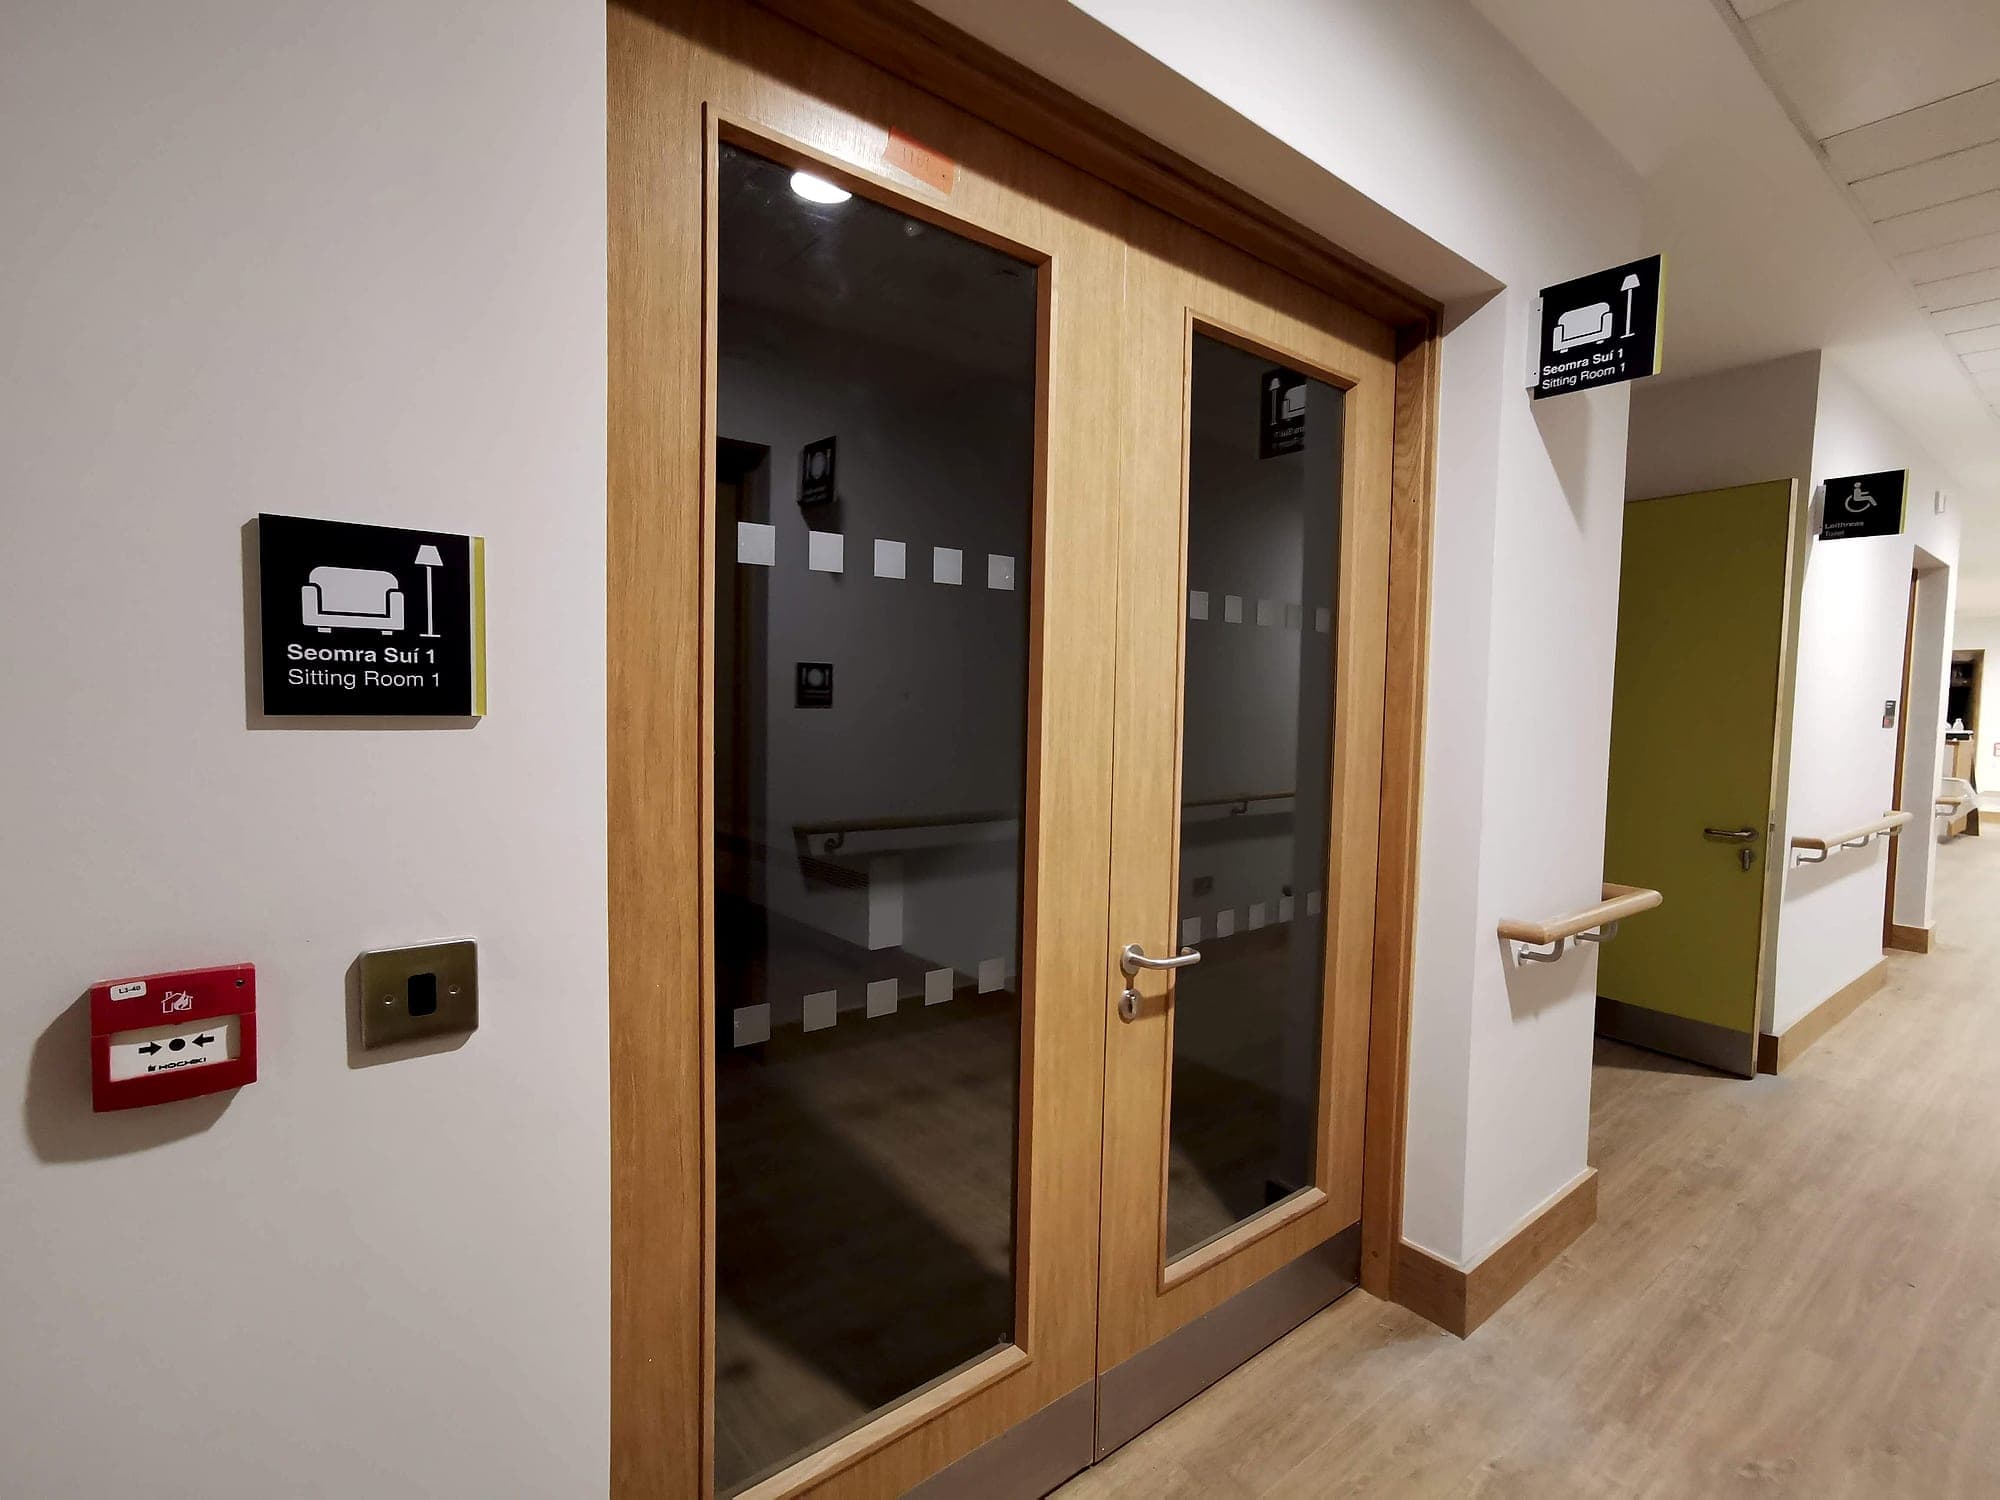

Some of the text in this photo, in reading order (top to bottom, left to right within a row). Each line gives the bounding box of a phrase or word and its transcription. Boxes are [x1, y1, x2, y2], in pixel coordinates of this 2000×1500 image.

[1542, 348, 1624, 376] Seomra Suí 1
[1542, 362, 1626, 390] Sitting Room 1
[287, 643, 435, 664] Seomra Suí 1
[288, 668, 439, 690] Sitting Room 1
